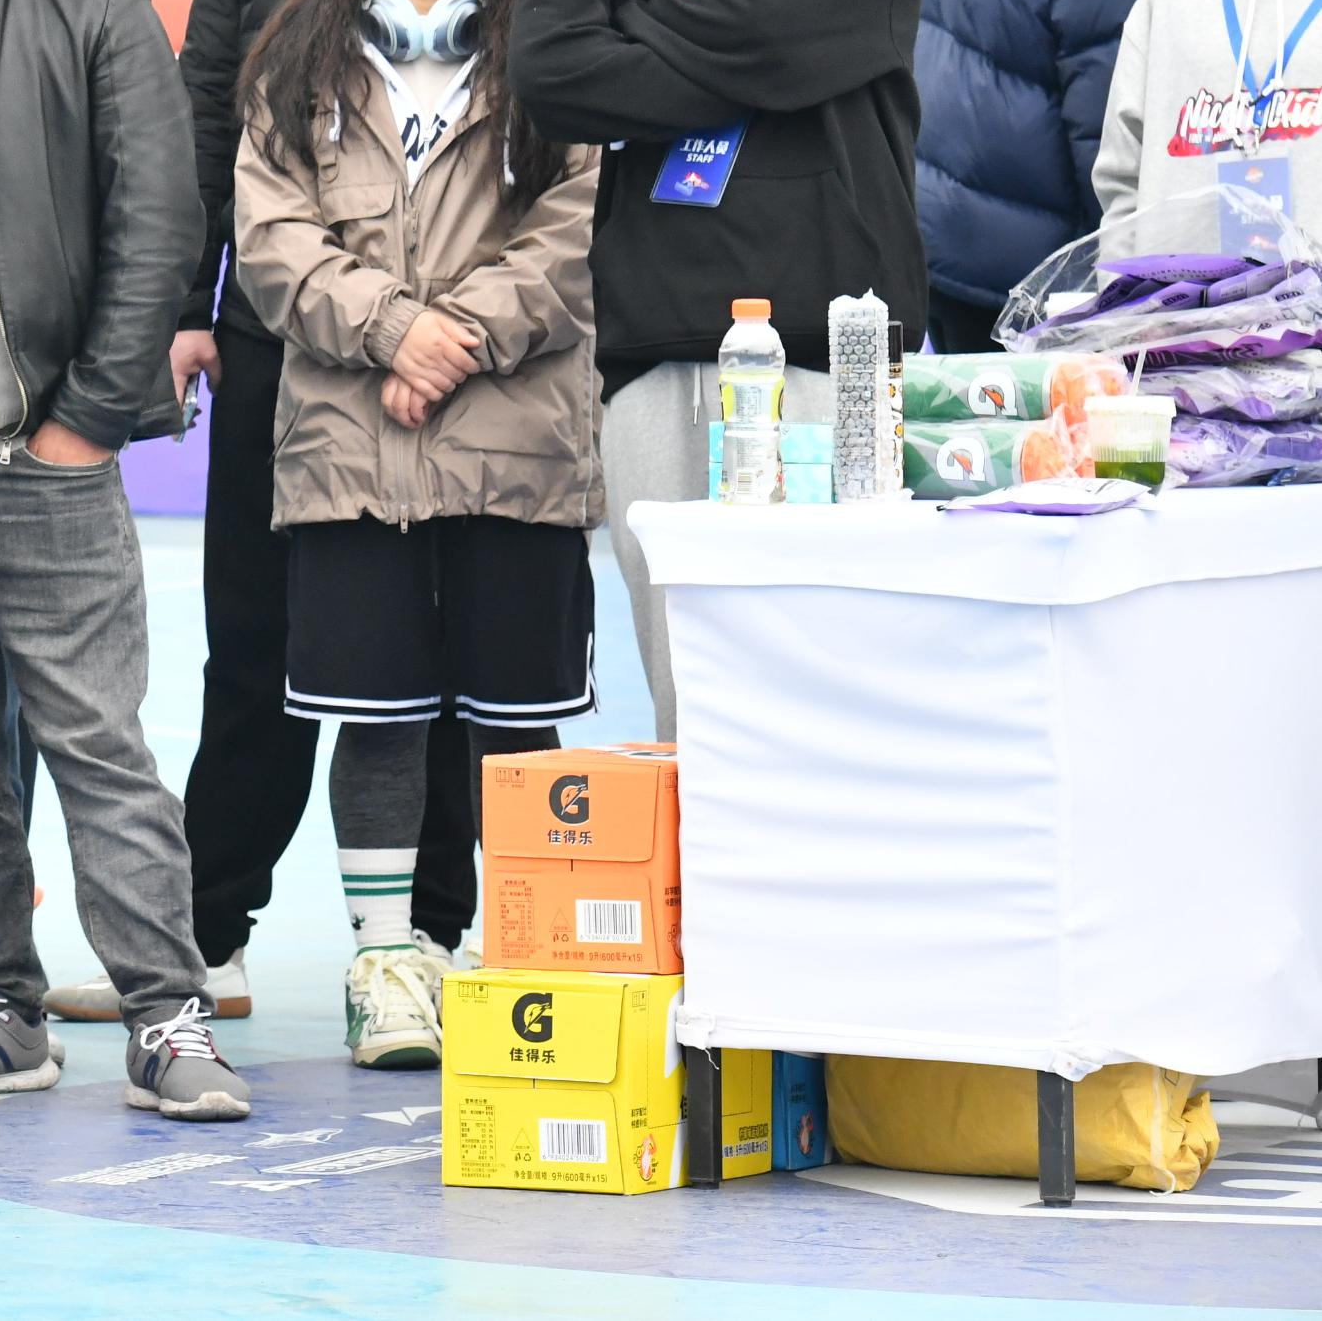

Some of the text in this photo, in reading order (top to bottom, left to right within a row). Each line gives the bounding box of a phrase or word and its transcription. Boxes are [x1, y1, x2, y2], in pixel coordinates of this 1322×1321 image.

[679, 138, 730, 155] 工作人员
[685, 153, 715, 163] STAFF
[549, 774, 589, 825] G
[547, 829, 593, 845] 佳得乐
[512, 992, 553, 1043] G
[509, 1047, 556, 1064] 佳得乐
